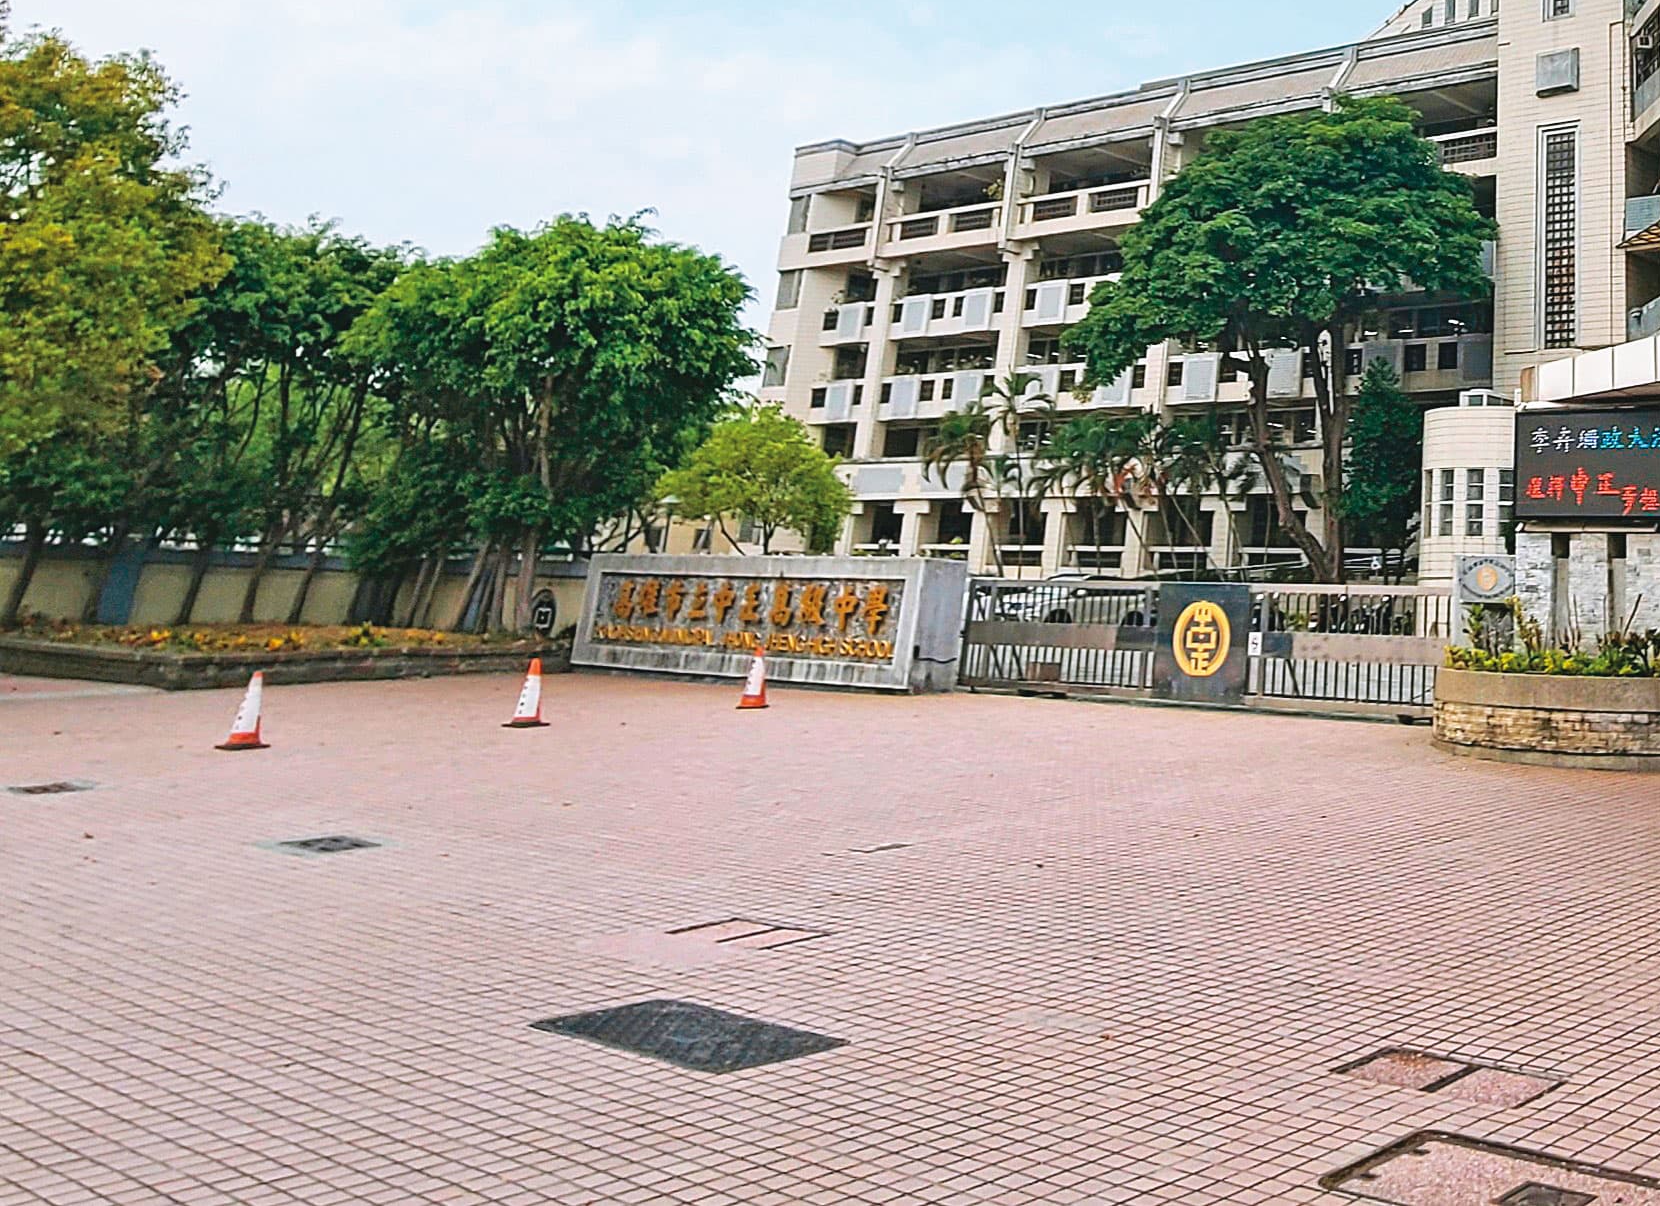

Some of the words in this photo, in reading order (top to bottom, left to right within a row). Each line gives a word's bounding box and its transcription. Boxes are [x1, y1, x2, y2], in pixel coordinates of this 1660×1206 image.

[614, 579, 890, 634] 高雄市立中正高級中學
[838, 638, 894, 658] SCHOOL
